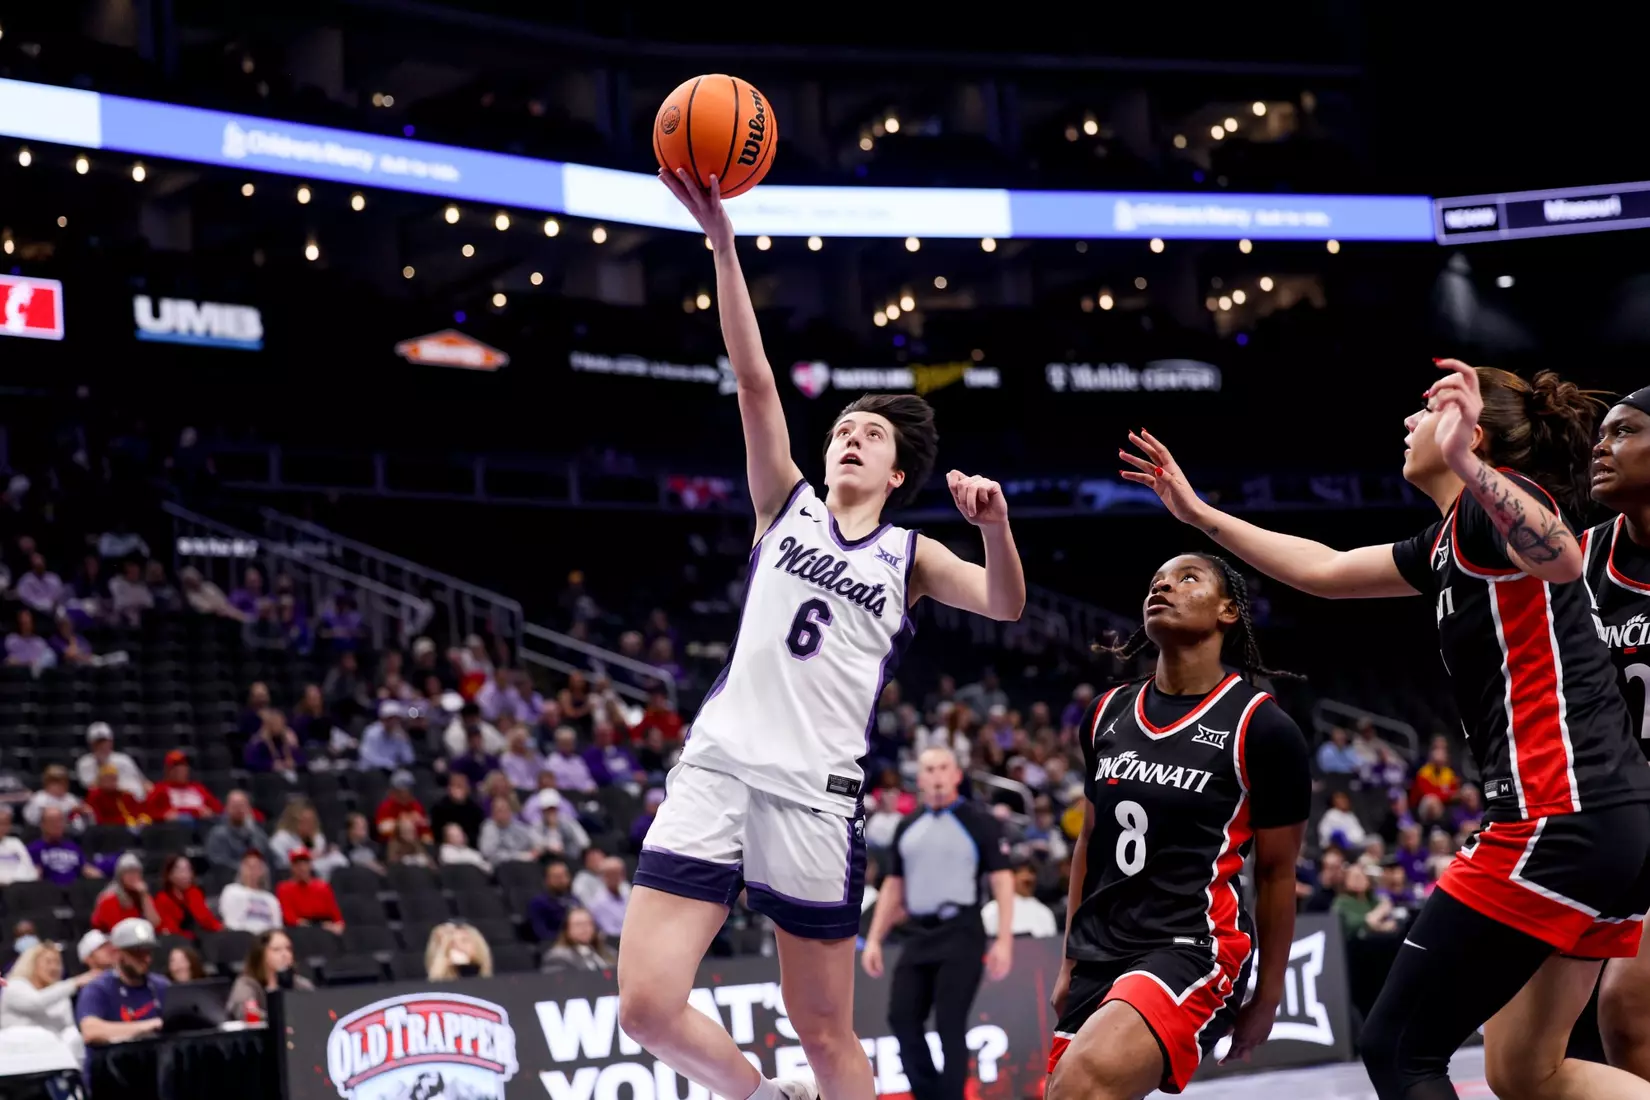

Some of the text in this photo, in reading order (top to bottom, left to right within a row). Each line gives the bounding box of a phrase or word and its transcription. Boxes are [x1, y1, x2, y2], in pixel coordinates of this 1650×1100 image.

[736, 88, 766, 166] Wilson
[133, 294, 263, 342] UMB
[774, 536, 887, 619] Wildcats
[785, 597, 833, 661] 6
[1191, 723, 1230, 750] XII
[1095, 751, 1214, 793] CINCINNATI
[1501, 783, 1509, 792] M
[1114, 800, 1149, 877] 8
[330, 1004, 515, 1085] OLD TRAPPER
